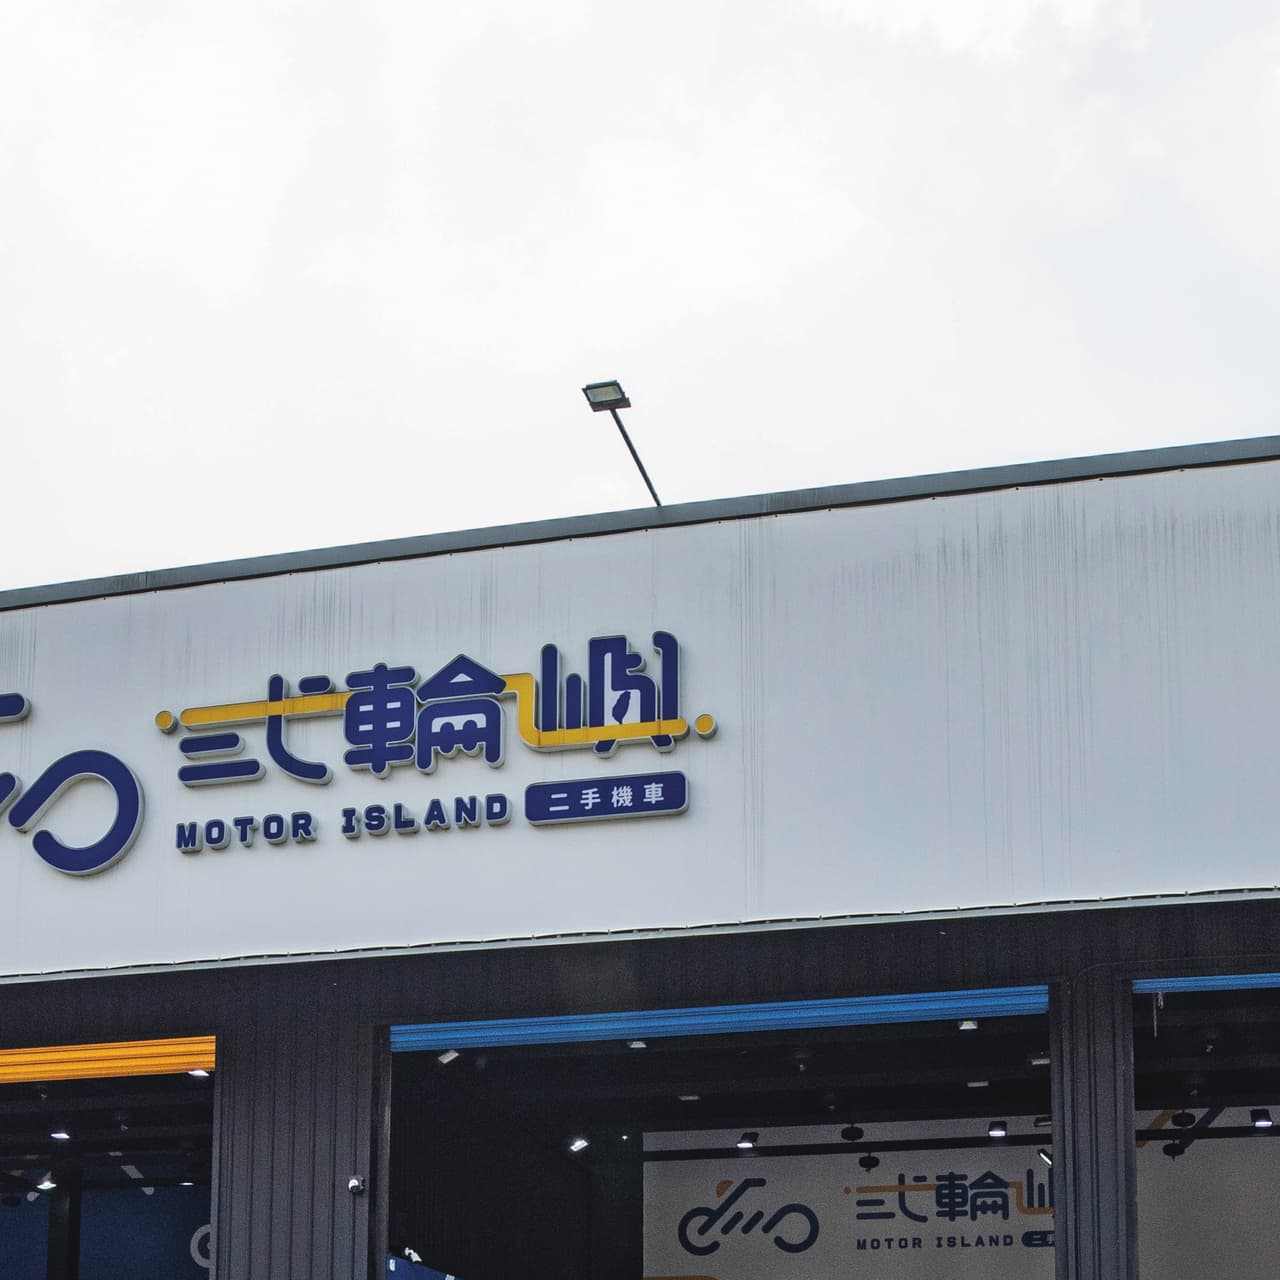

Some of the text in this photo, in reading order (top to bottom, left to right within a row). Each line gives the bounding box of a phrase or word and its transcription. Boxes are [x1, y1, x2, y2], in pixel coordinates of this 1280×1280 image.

[548, 781, 666, 813] 二手機車
[176, 793, 511, 851] MOTOR ISLAND
[856, 1237, 923, 1250] MOTOR
[936, 1234, 1014, 1249] ISLAND
